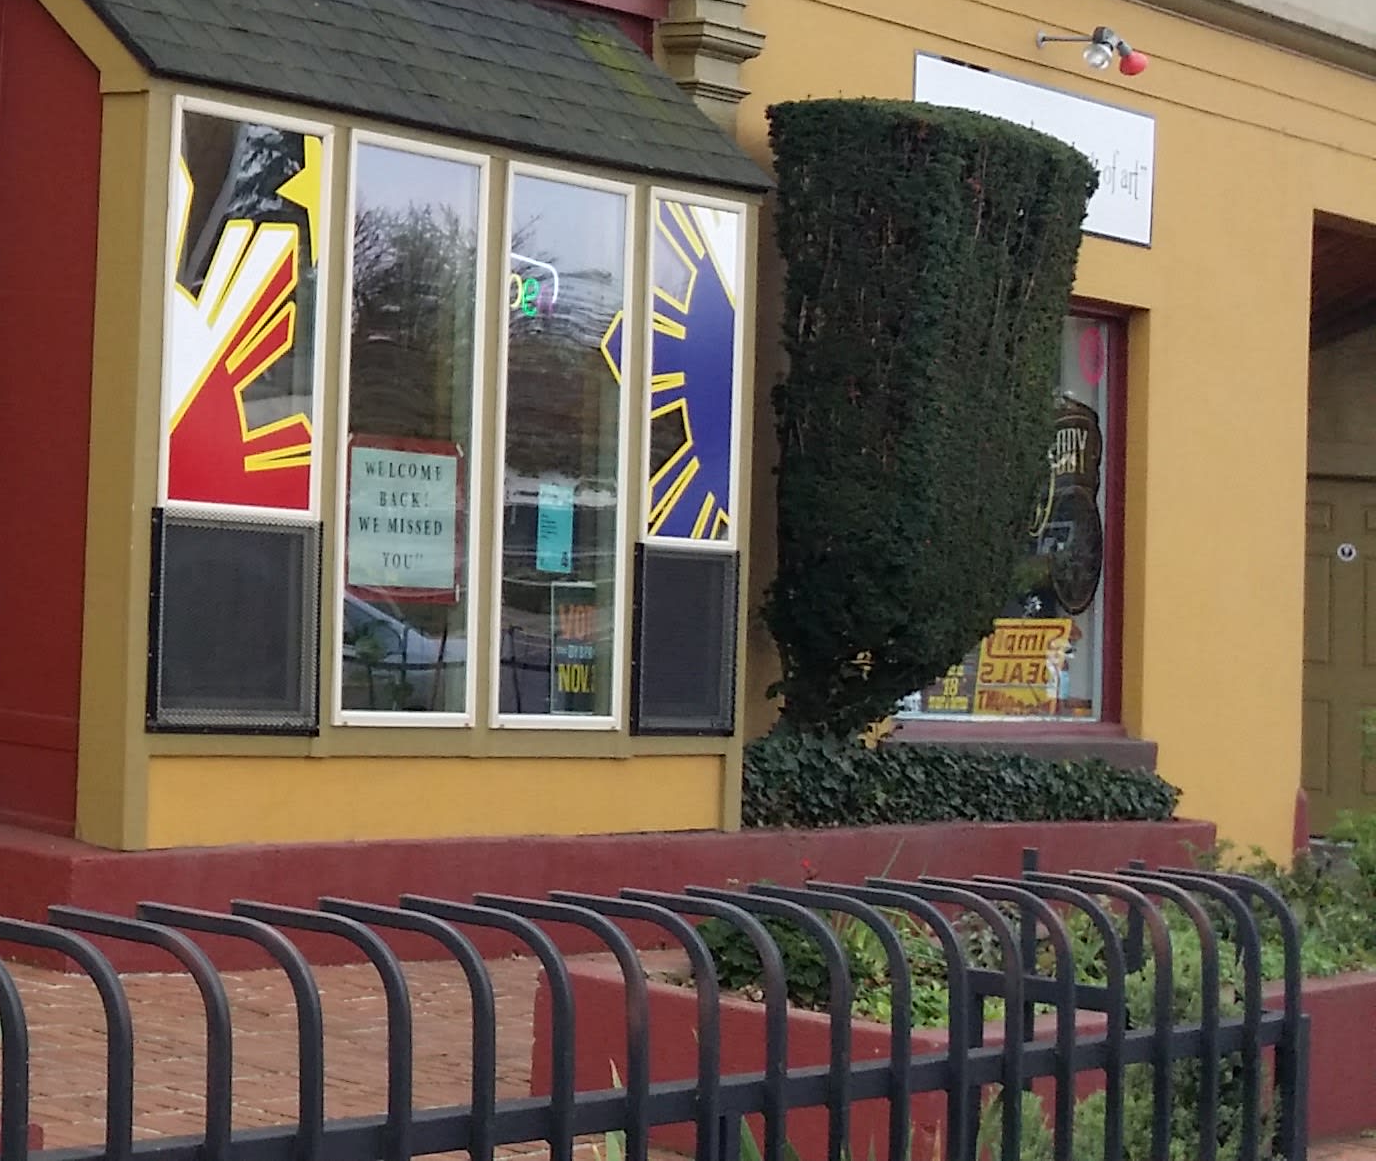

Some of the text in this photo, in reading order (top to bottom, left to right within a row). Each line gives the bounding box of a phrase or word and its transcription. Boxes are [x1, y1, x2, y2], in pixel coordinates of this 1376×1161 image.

[365, 460, 443, 481] WELCOME
[358, 516, 443, 536] WE MISSED
